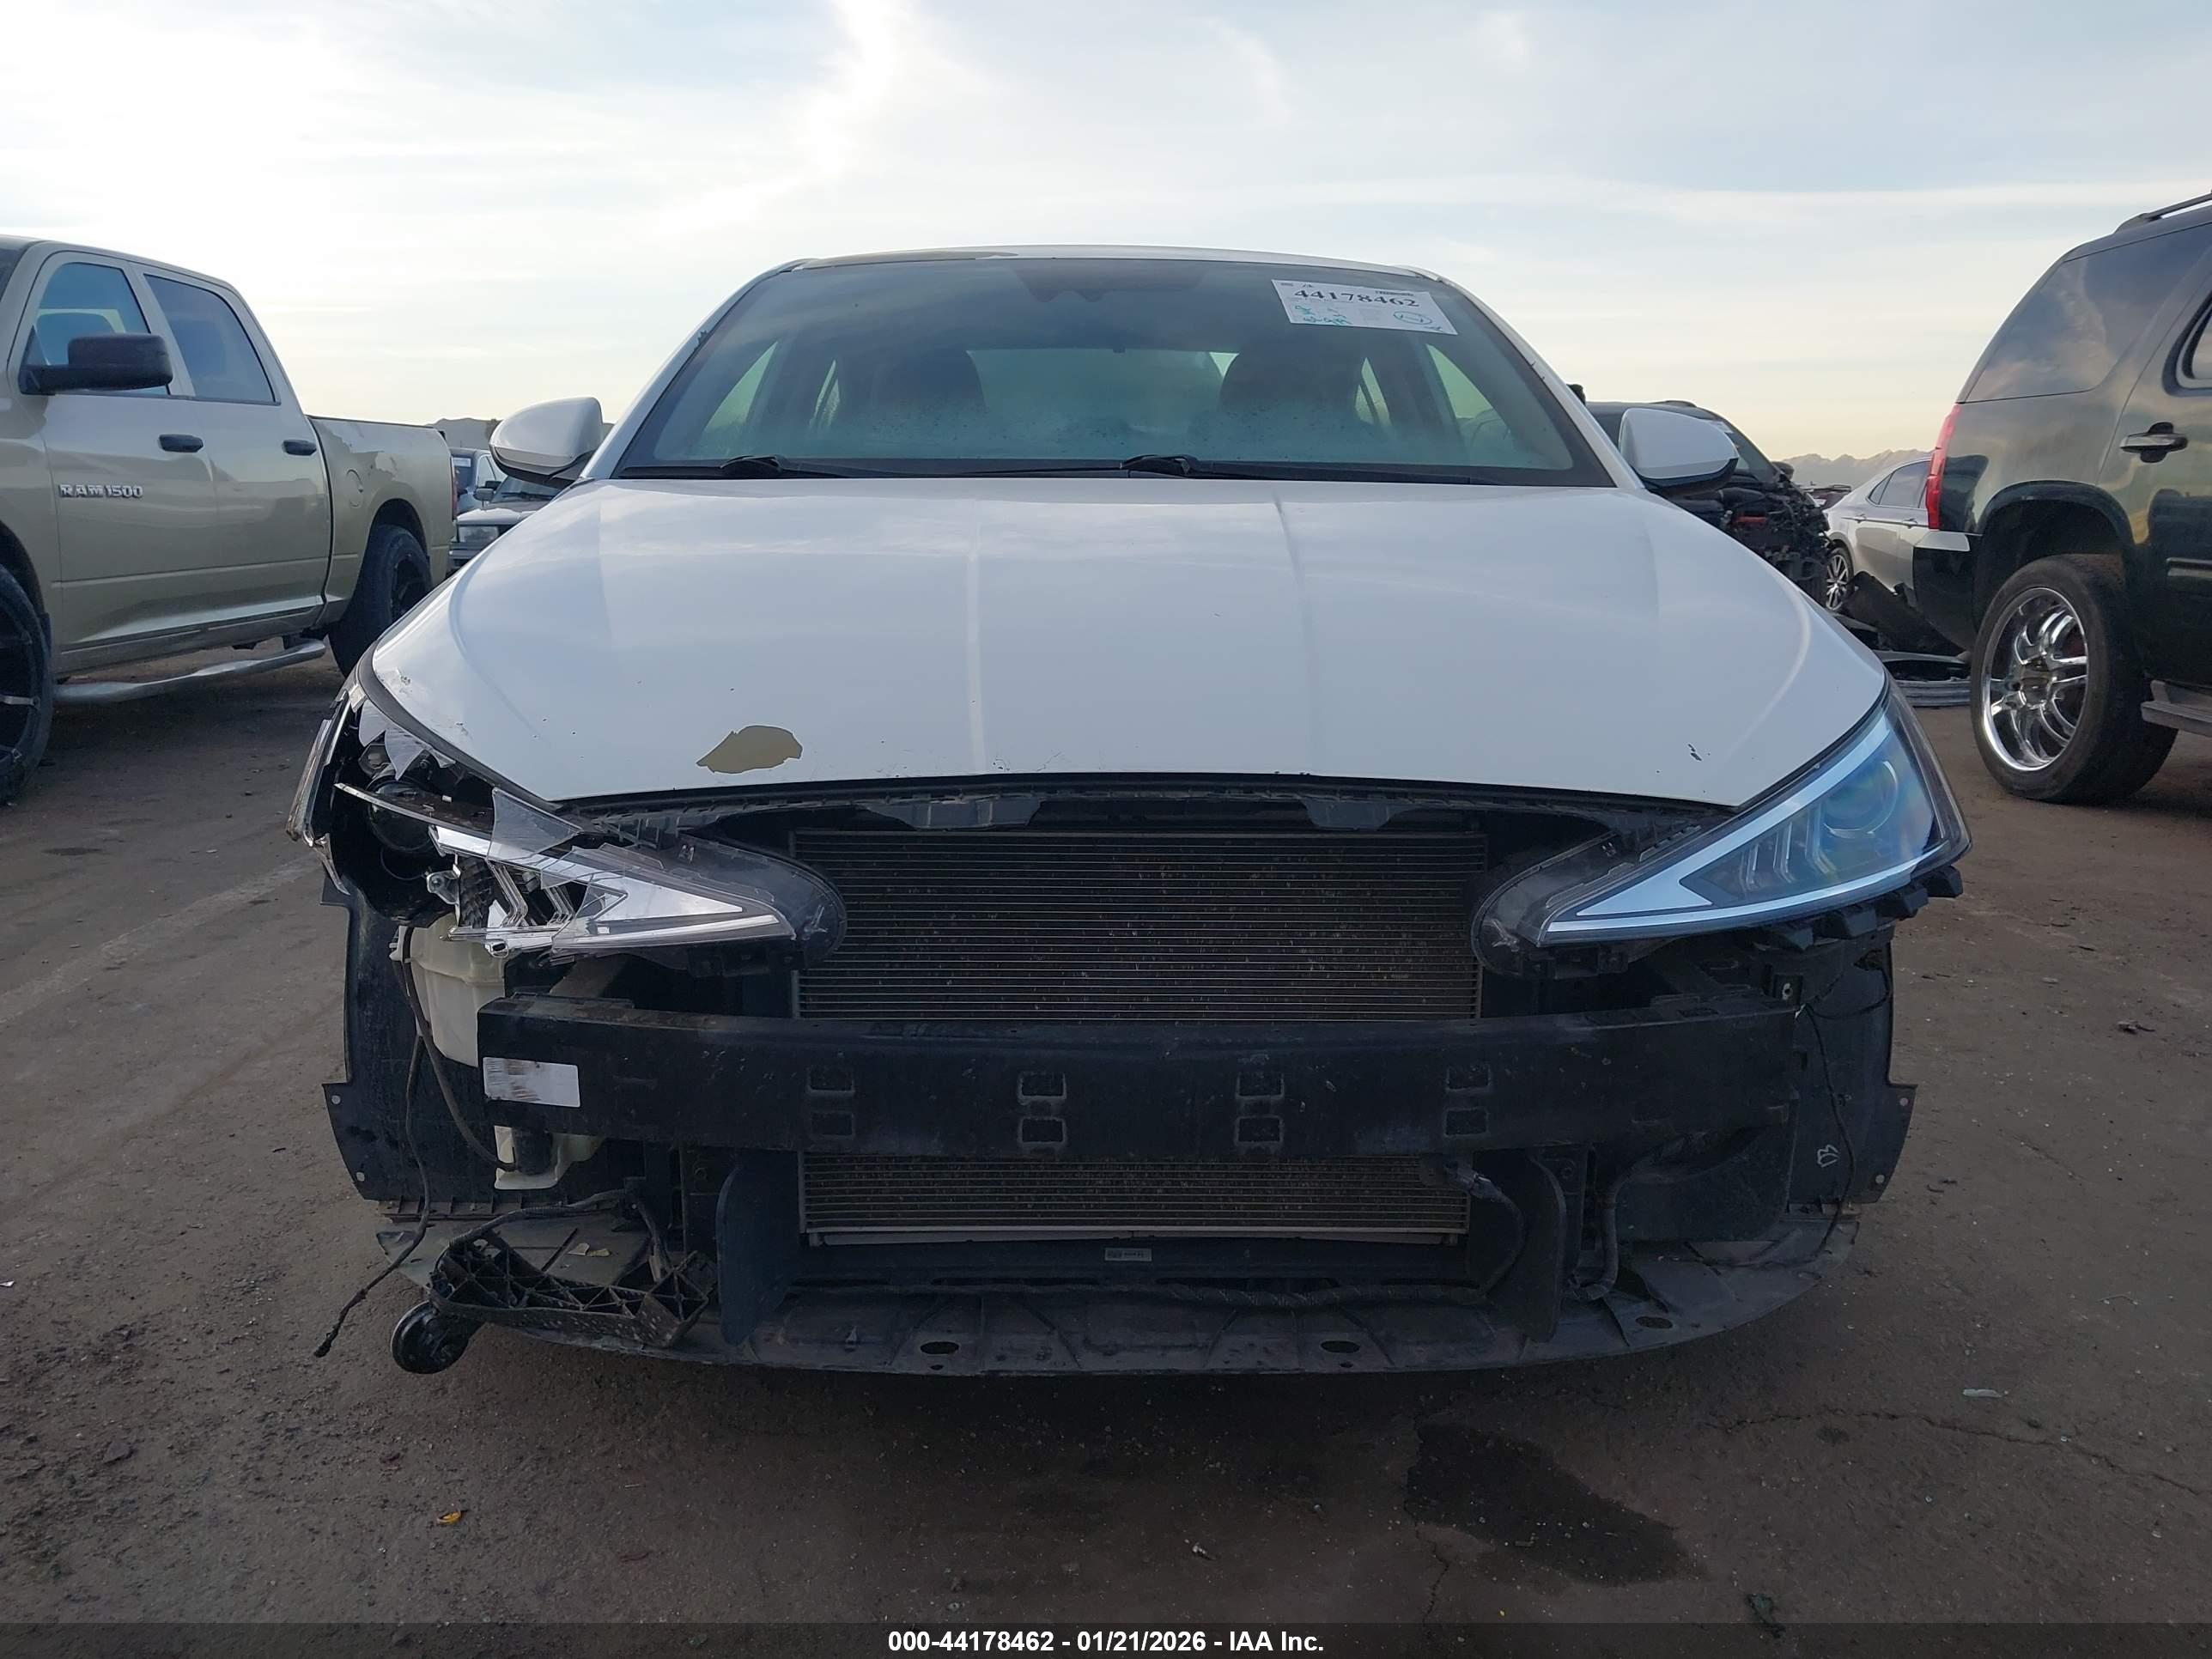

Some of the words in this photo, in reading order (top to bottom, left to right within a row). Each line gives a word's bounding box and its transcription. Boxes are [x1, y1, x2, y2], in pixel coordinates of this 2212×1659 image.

[1295, 289, 1420, 307] 44178462
[58, 484, 103, 498] RAM
[105, 484, 143, 498] 1500
